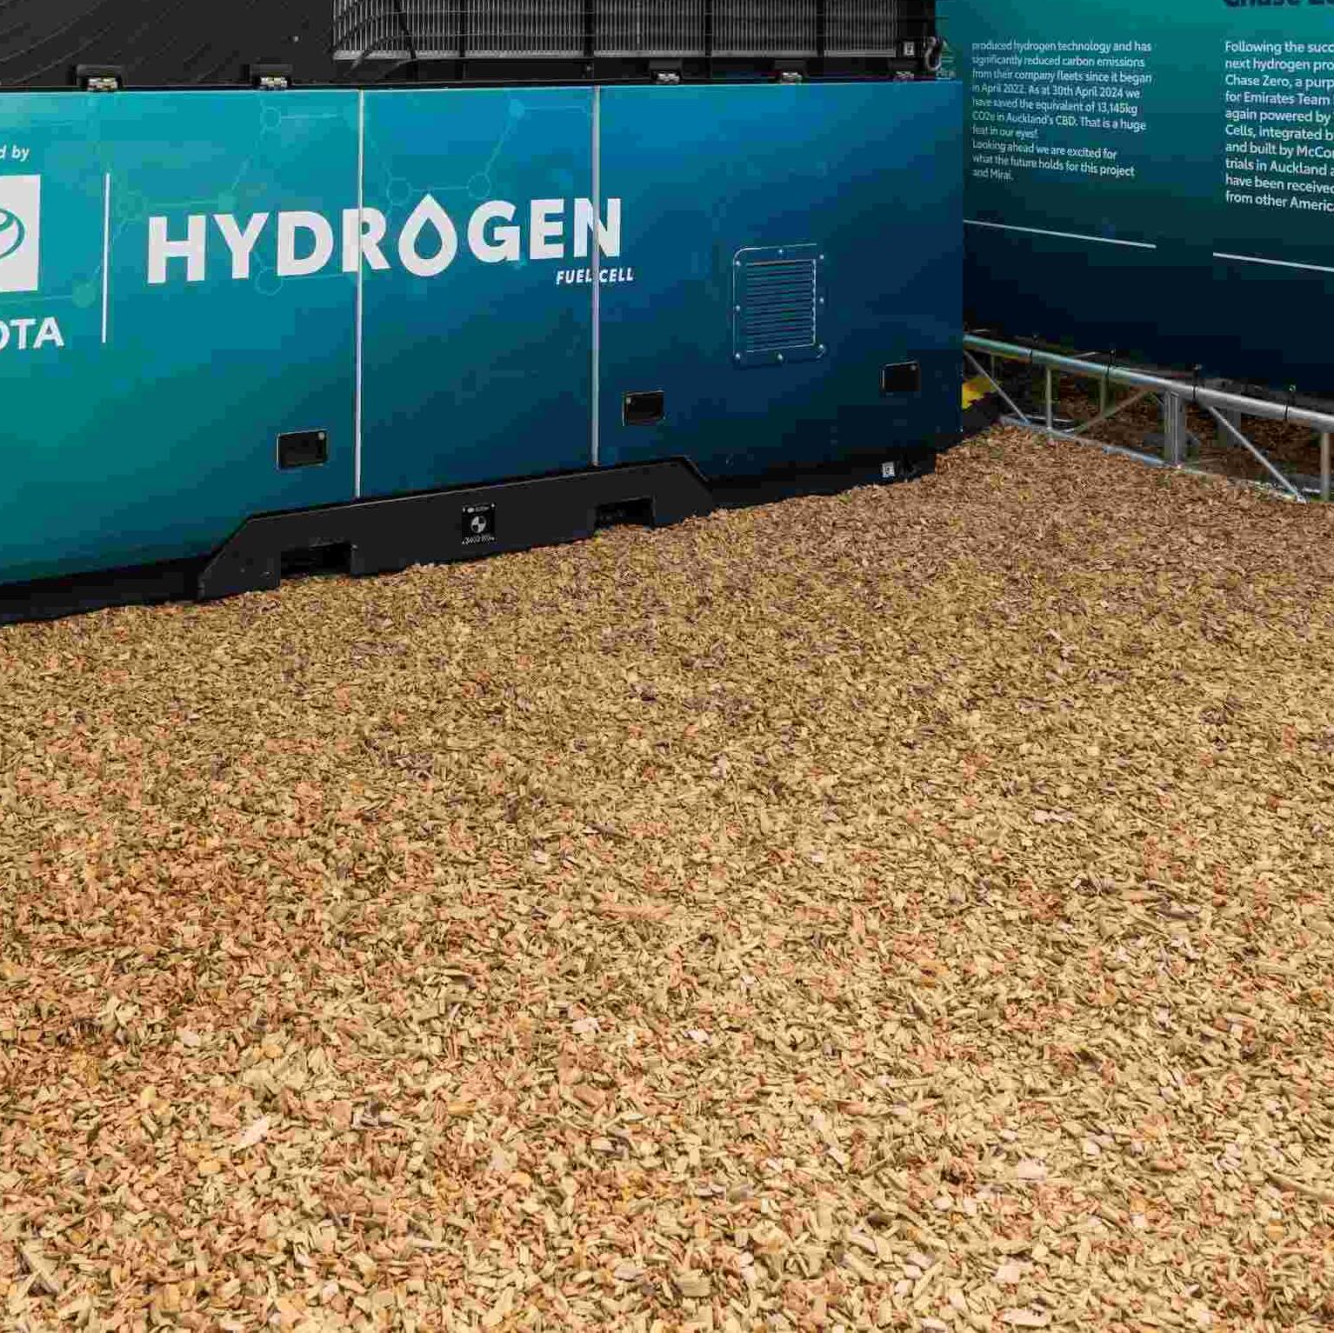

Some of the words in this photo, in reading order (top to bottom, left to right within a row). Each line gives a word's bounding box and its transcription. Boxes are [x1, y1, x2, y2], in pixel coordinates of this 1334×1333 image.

[1225, 41, 1282, 55] Following
[1284, 41, 1304, 52] the
[1225, 59, 1251, 69] next
[1253, 58, 1310, 73] hydrogen
[1225, 75, 1260, 86] Chase
[1262, 76, 1293, 90] Zero,
[1294, 79, 1303, 87] a
[1225, 92, 1241, 102] for
[1243, 92, 1295, 104] Emirates
[1297, 94, 1330, 105] Team
[1225, 110, 1257, 122] again
[1259, 111, 1312, 124] powered
[1315, 112, 1330, 126] by
[1225, 125, 1256, 140] Cells,
[1259, 128, 1323, 142] integrated
[12, 146, 30, 162] by
[1225, 142, 1248, 153] and
[1250, 143, 1277, 155] built
[1279, 145, 1294, 159] by
[1225, 159, 1254, 171] trials
[1256, 162, 1267, 172] in
[1269, 161, 1327, 176] Auckland
[1225, 175, 1252, 187] have
[1255, 177, 1284, 190] been
[1225, 192, 1252, 204] from
[1255, 195, 1287, 207] other
[147, 193, 621, 284] HYDROGEN
[556, 269, 593, 285] FUEL
[599, 267, 634, 283] CELL
